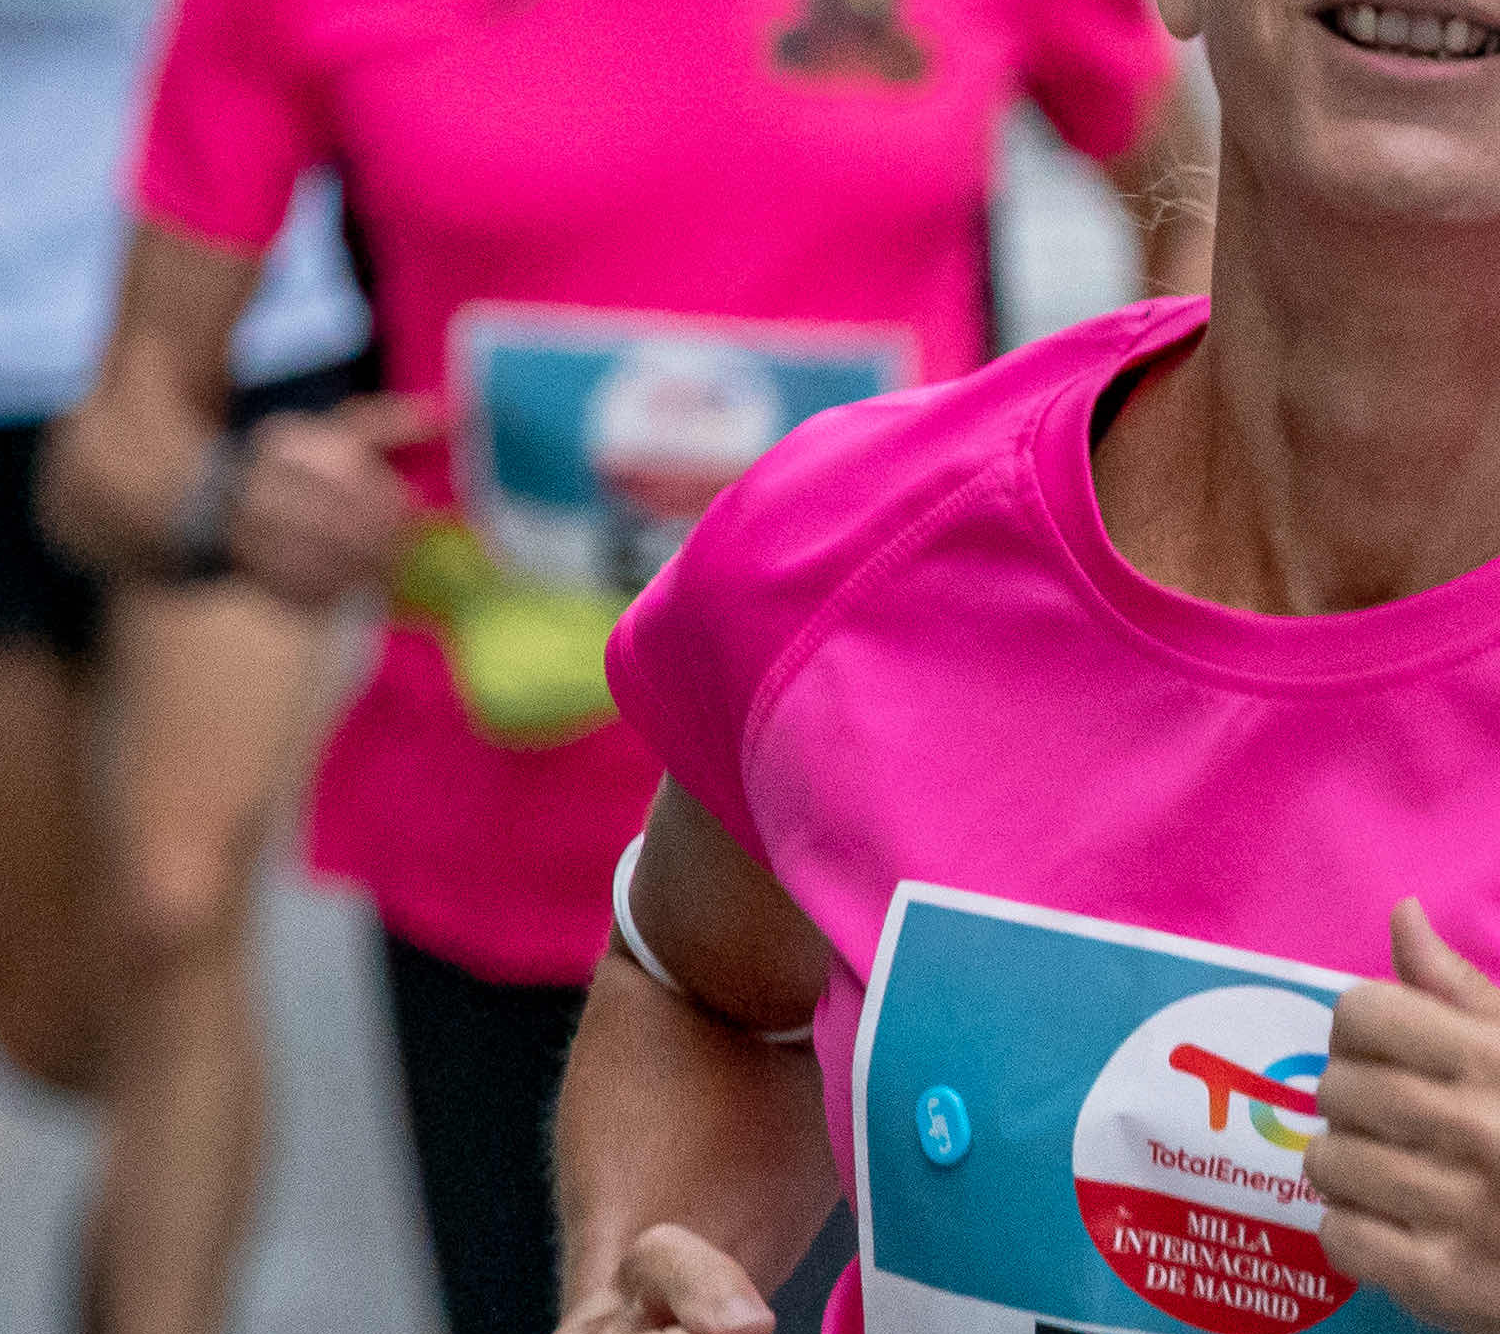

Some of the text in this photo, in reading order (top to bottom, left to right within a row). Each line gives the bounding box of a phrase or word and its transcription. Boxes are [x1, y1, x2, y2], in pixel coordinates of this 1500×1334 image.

[1148, 1139, 1324, 1204] TotalEnergie
[1187, 1210, 1273, 1256] MILLA
[1112, 1226, 1334, 1304] INTERNACIONAL
[1145, 1262, 1300, 1322] DE MADRID
